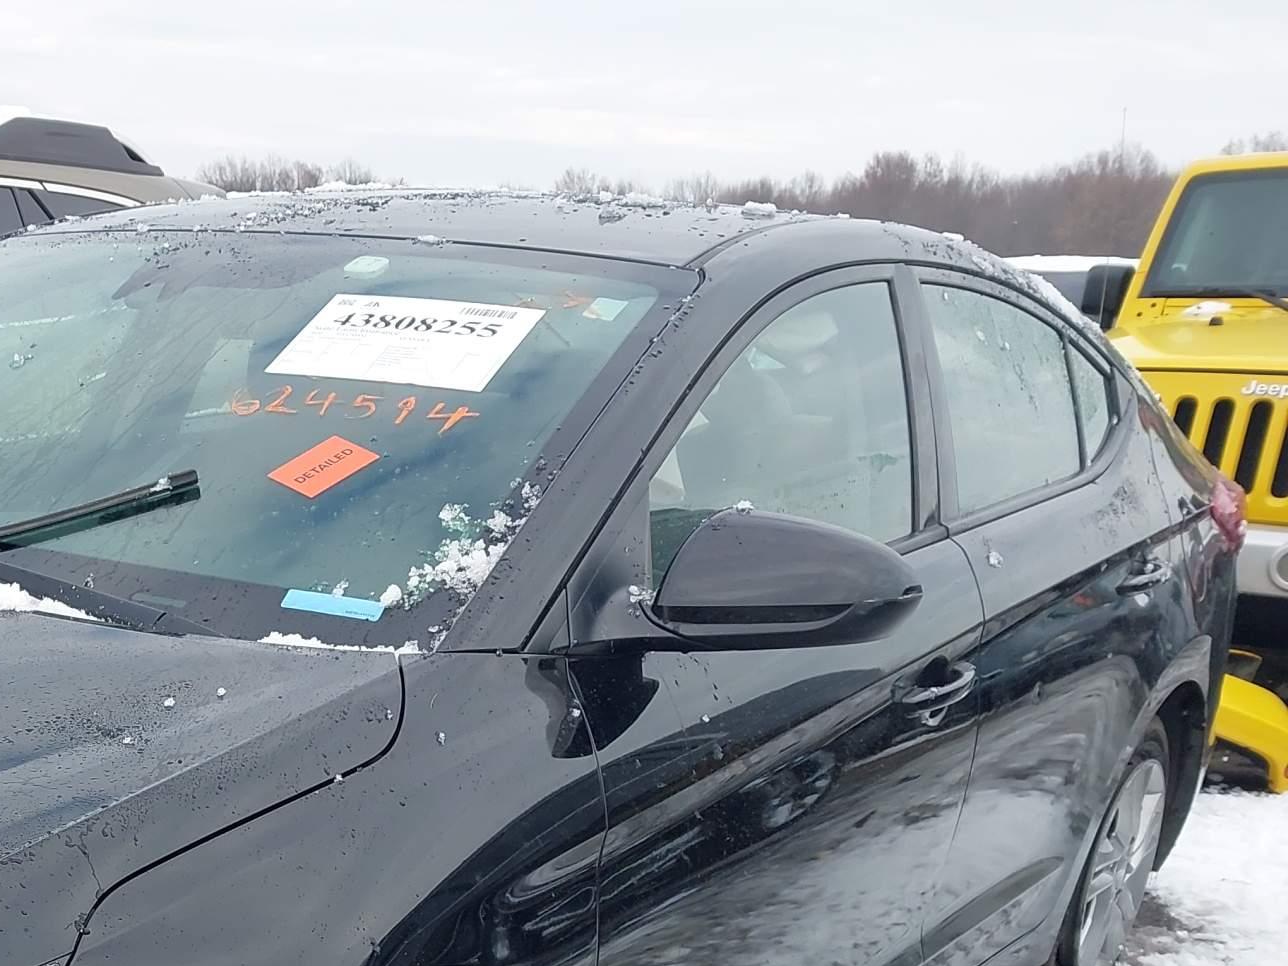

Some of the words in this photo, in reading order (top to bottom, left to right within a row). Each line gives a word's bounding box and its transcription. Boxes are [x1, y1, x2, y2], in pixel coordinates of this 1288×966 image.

[333, 312, 505, 338] 43808255
[1240, 379, 1288, 398] Jeep
[293, 447, 354, 485] DETAILED
